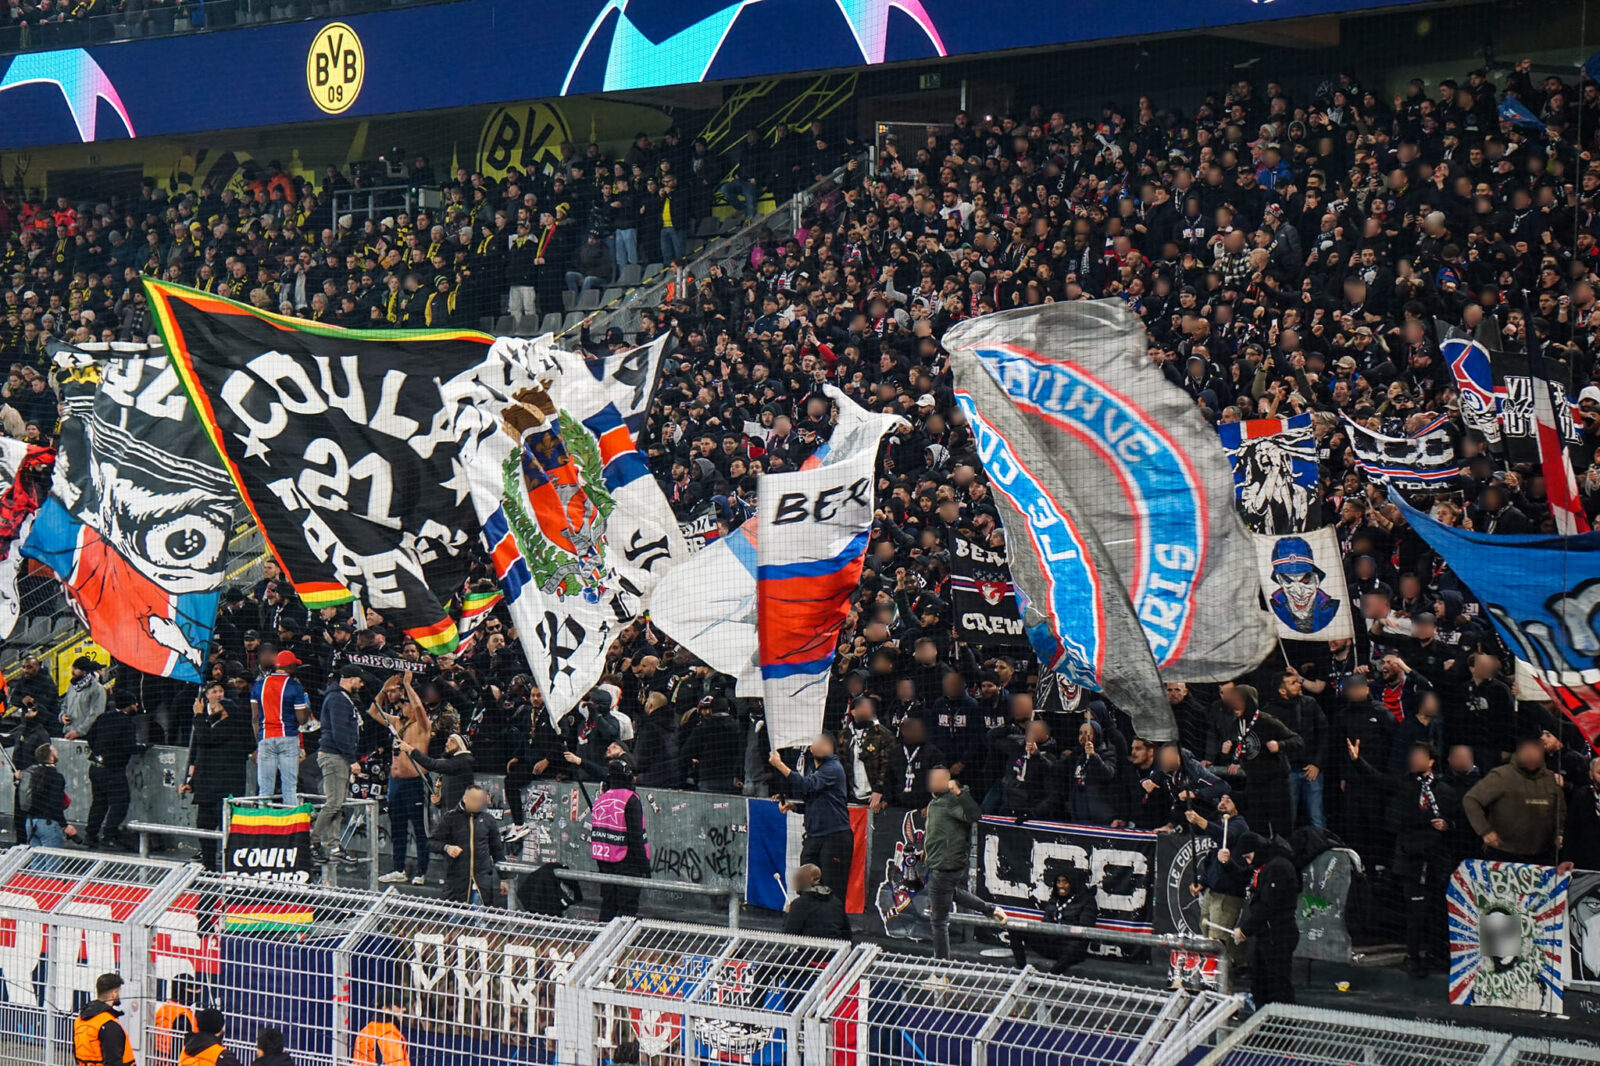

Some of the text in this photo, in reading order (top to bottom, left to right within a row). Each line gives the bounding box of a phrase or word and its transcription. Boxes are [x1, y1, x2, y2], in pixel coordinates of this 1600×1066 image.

[316, 33, 356, 86] BVB
[328, 85, 343, 103] 09
[299, 438, 402, 531] 27
[955, 537, 1008, 567] BER
[962, 612, 1024, 635] CREW
[233, 847, 298, 868] COULY
[592, 844, 610, 858] 022
[984, 834, 1149, 912] LCC
[1169, 869, 1181, 889] LE
[1489, 866, 1547, 899] BASE
